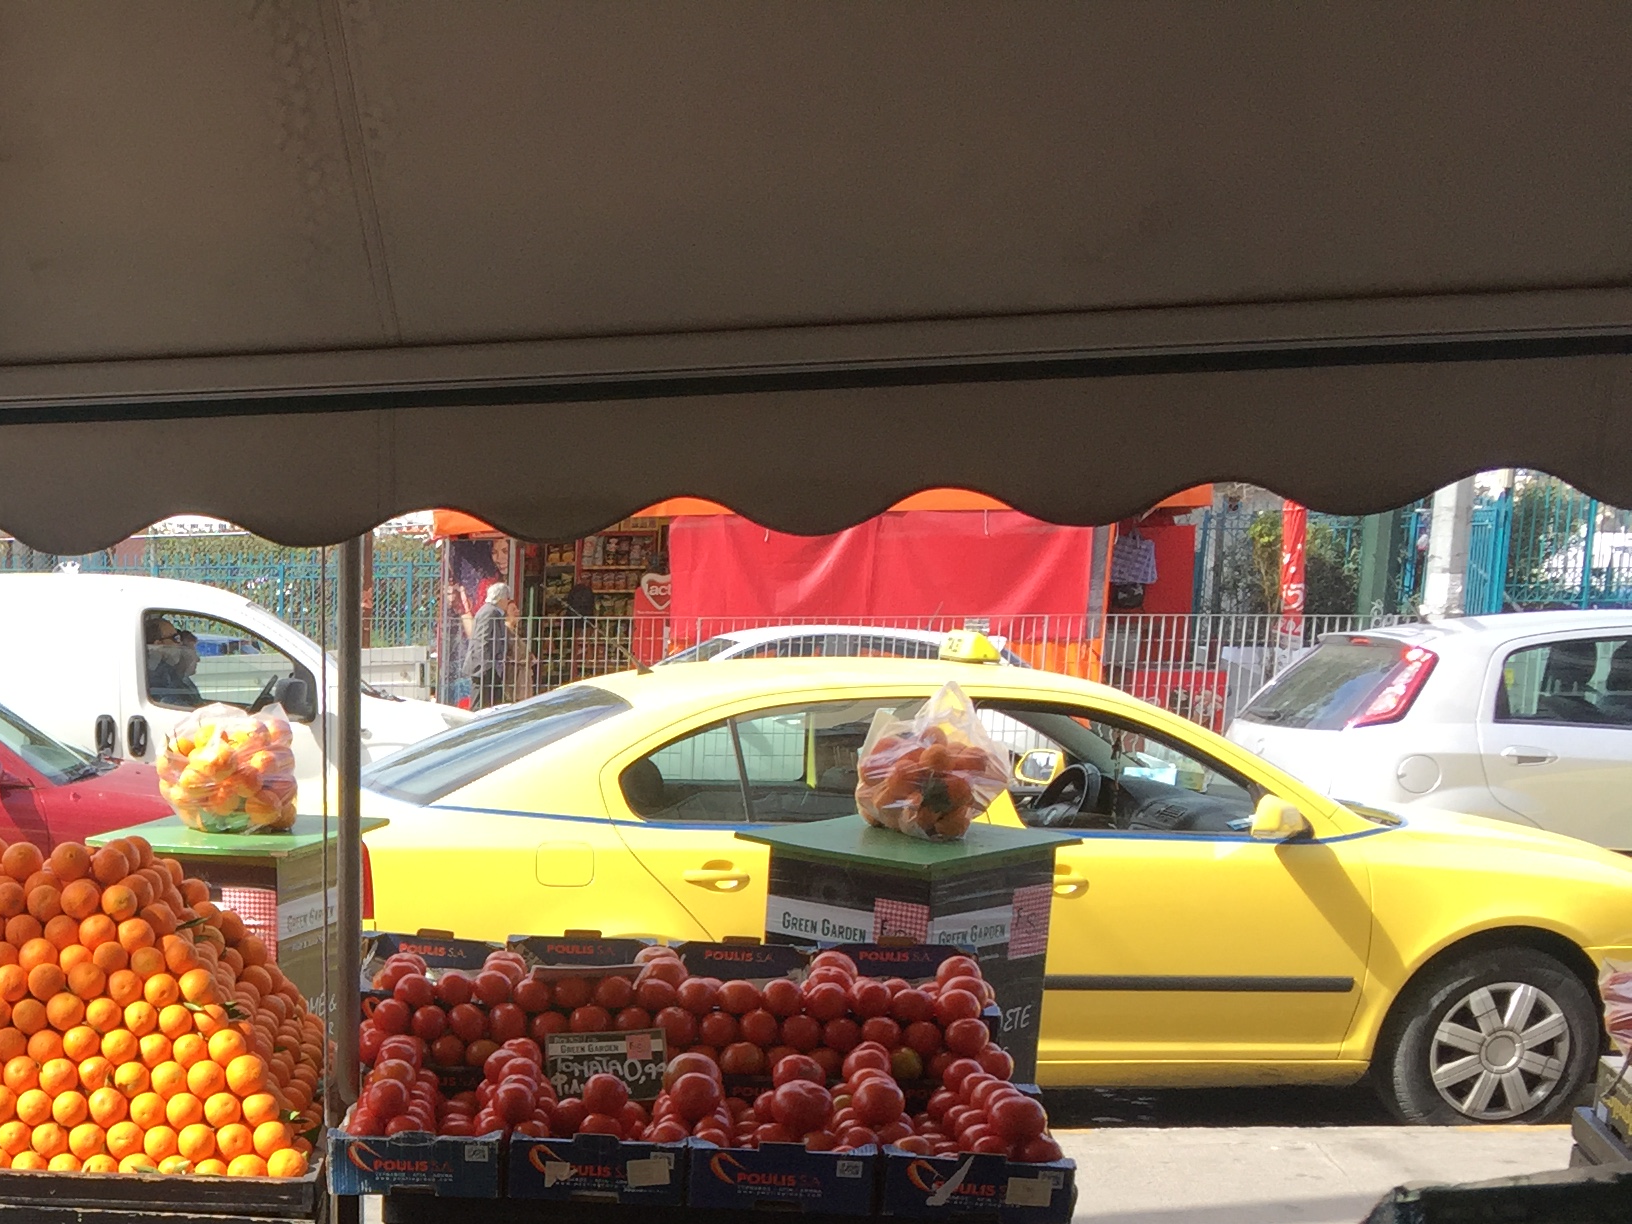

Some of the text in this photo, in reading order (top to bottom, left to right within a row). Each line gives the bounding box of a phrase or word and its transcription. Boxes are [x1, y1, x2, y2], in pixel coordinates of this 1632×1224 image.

[782, 911, 866, 943] GREEN GARDEN
[970, 924, 1006, 943] GARDEN
[398, 942, 446, 957] POULIS
[547, 944, 594, 955] POULIS
[704, 950, 753, 962] POULIS
[858, 950, 910, 962] POULIS
[588, 1043, 619, 1053] GARDEN
[373, 1159, 428, 1172] POULIS
[737, 1172, 797, 1187] POULIS
